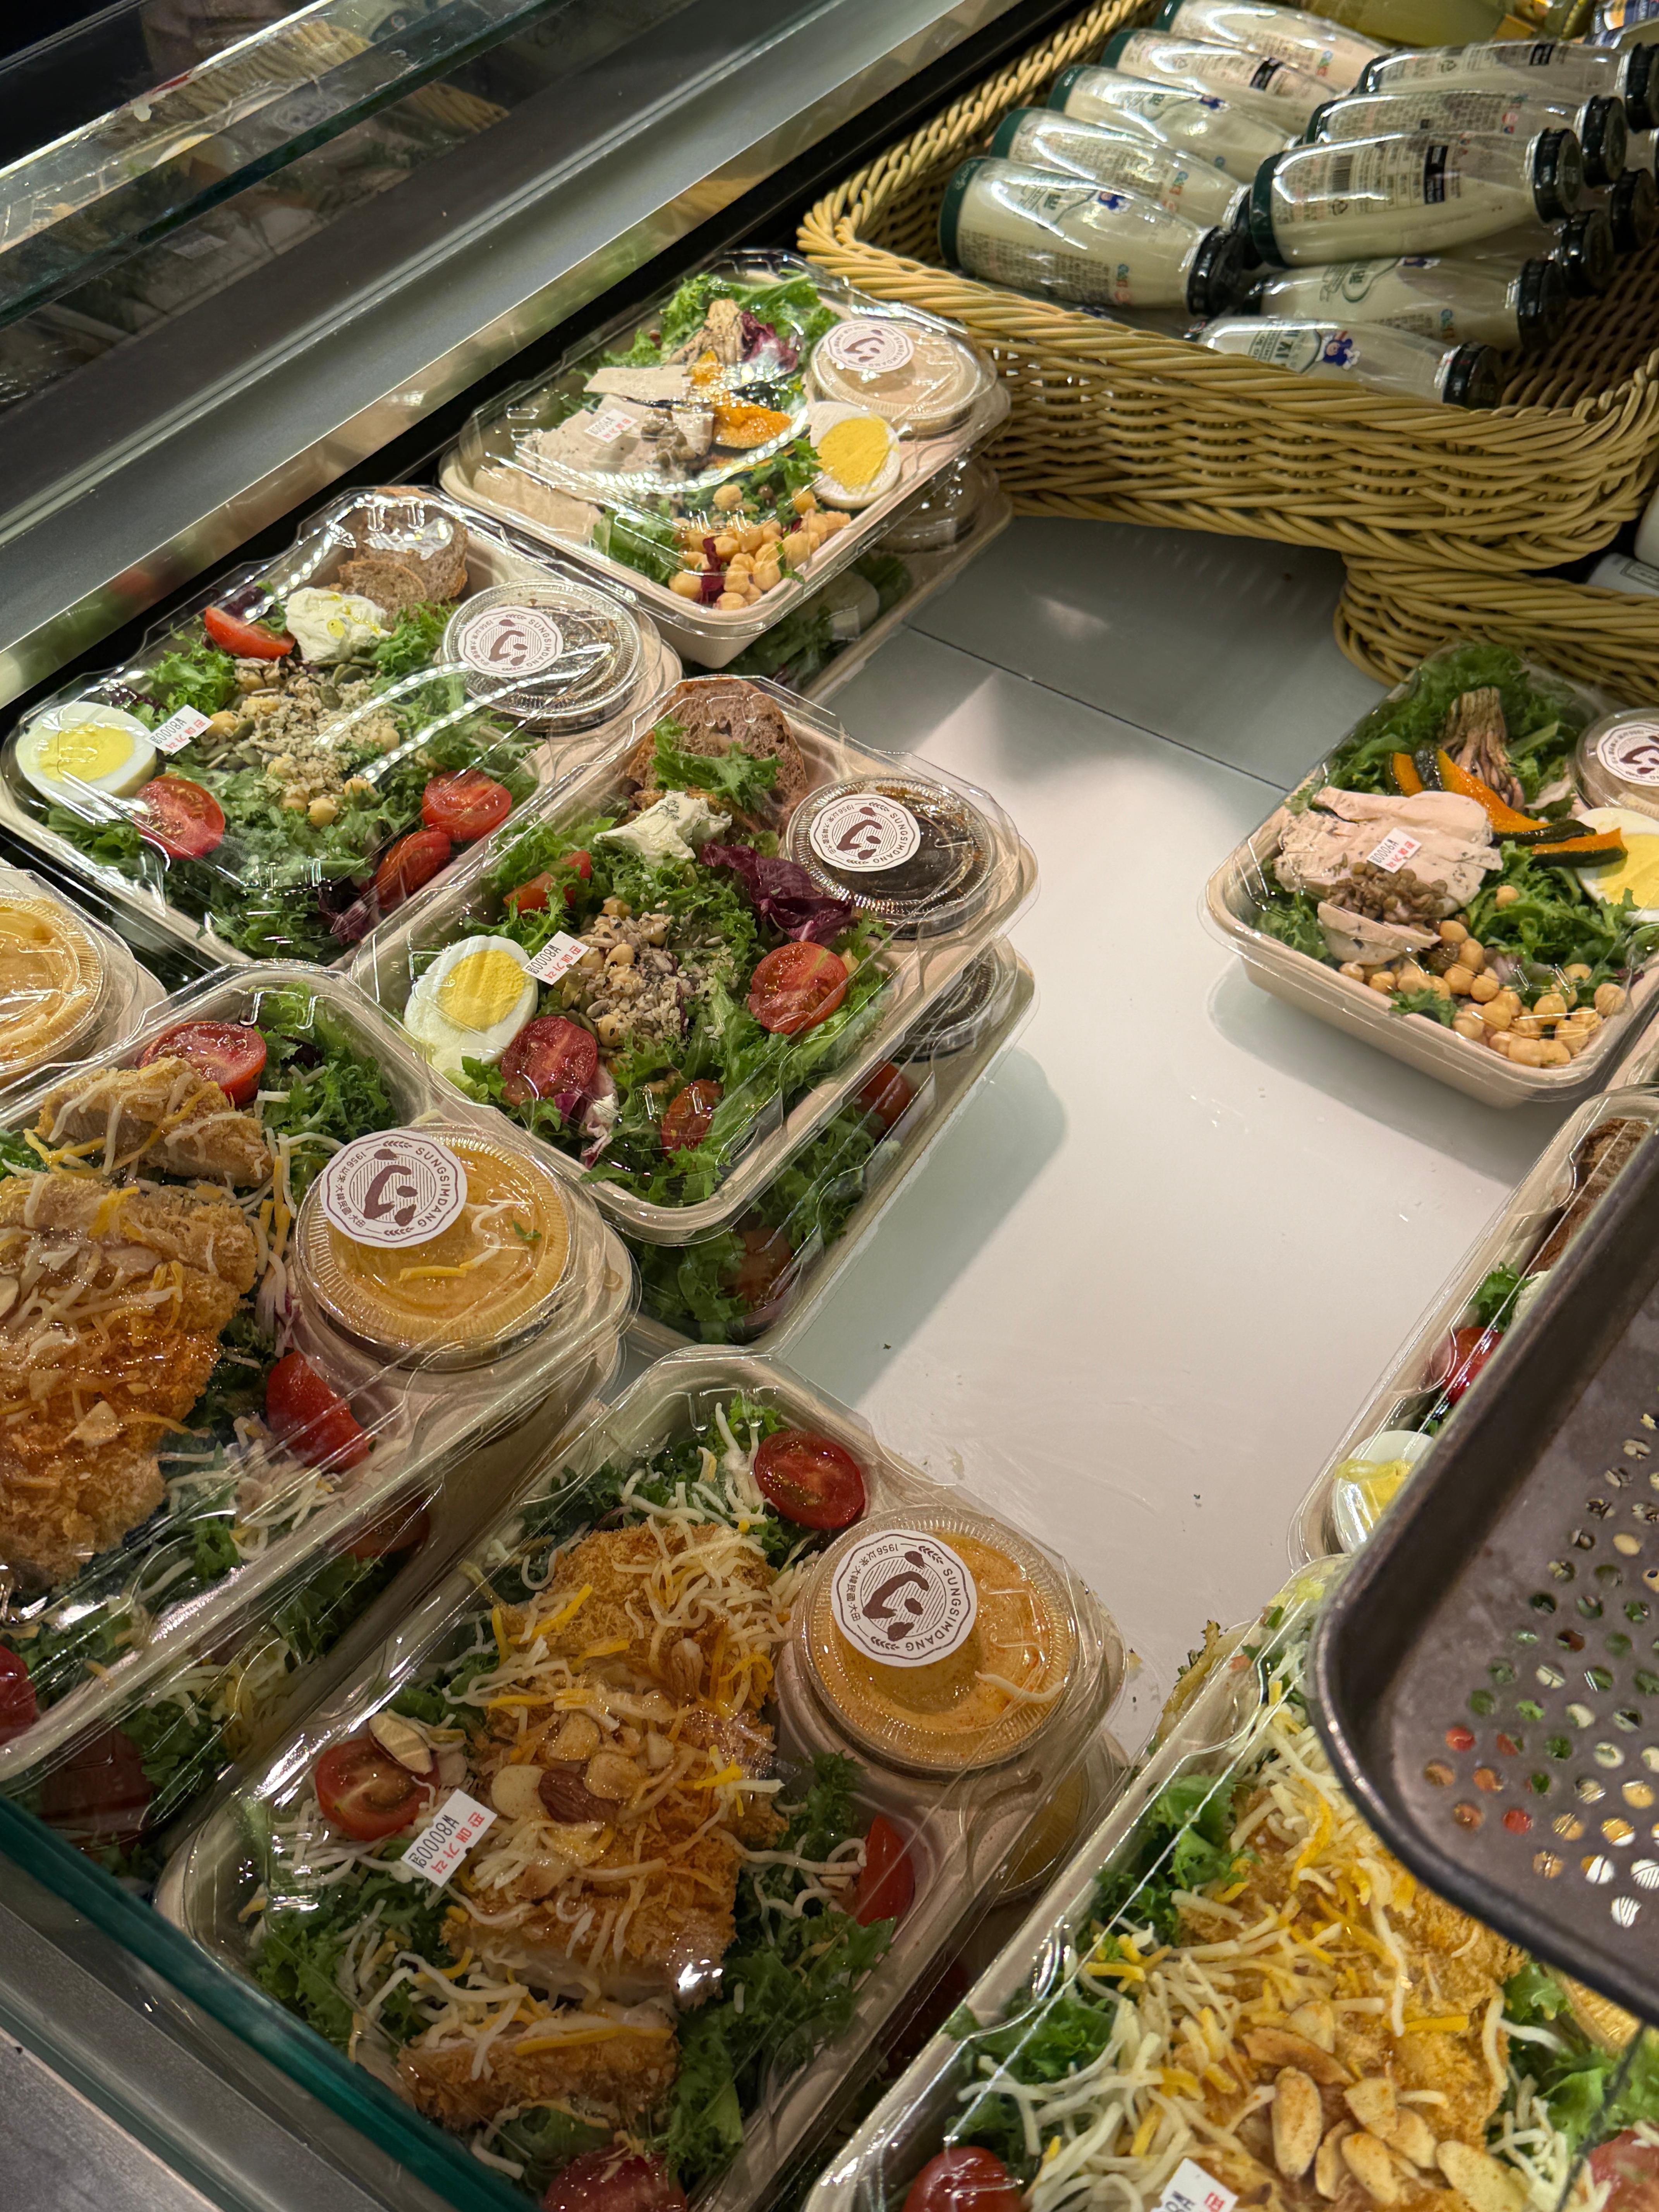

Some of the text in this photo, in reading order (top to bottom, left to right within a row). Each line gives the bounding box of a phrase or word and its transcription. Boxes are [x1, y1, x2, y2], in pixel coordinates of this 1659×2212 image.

[526, 618, 553, 668] SUNGSIMDANG
[872, 812, 908, 864] SUNGSIMDANG
[347, 1151, 367, 1168] 1956
[416, 1147, 451, 1228] SUNGSIMDANG
[877, 1543, 899, 1555] 1956
[905, 1568, 962, 1652] SUNGSIMDANG
